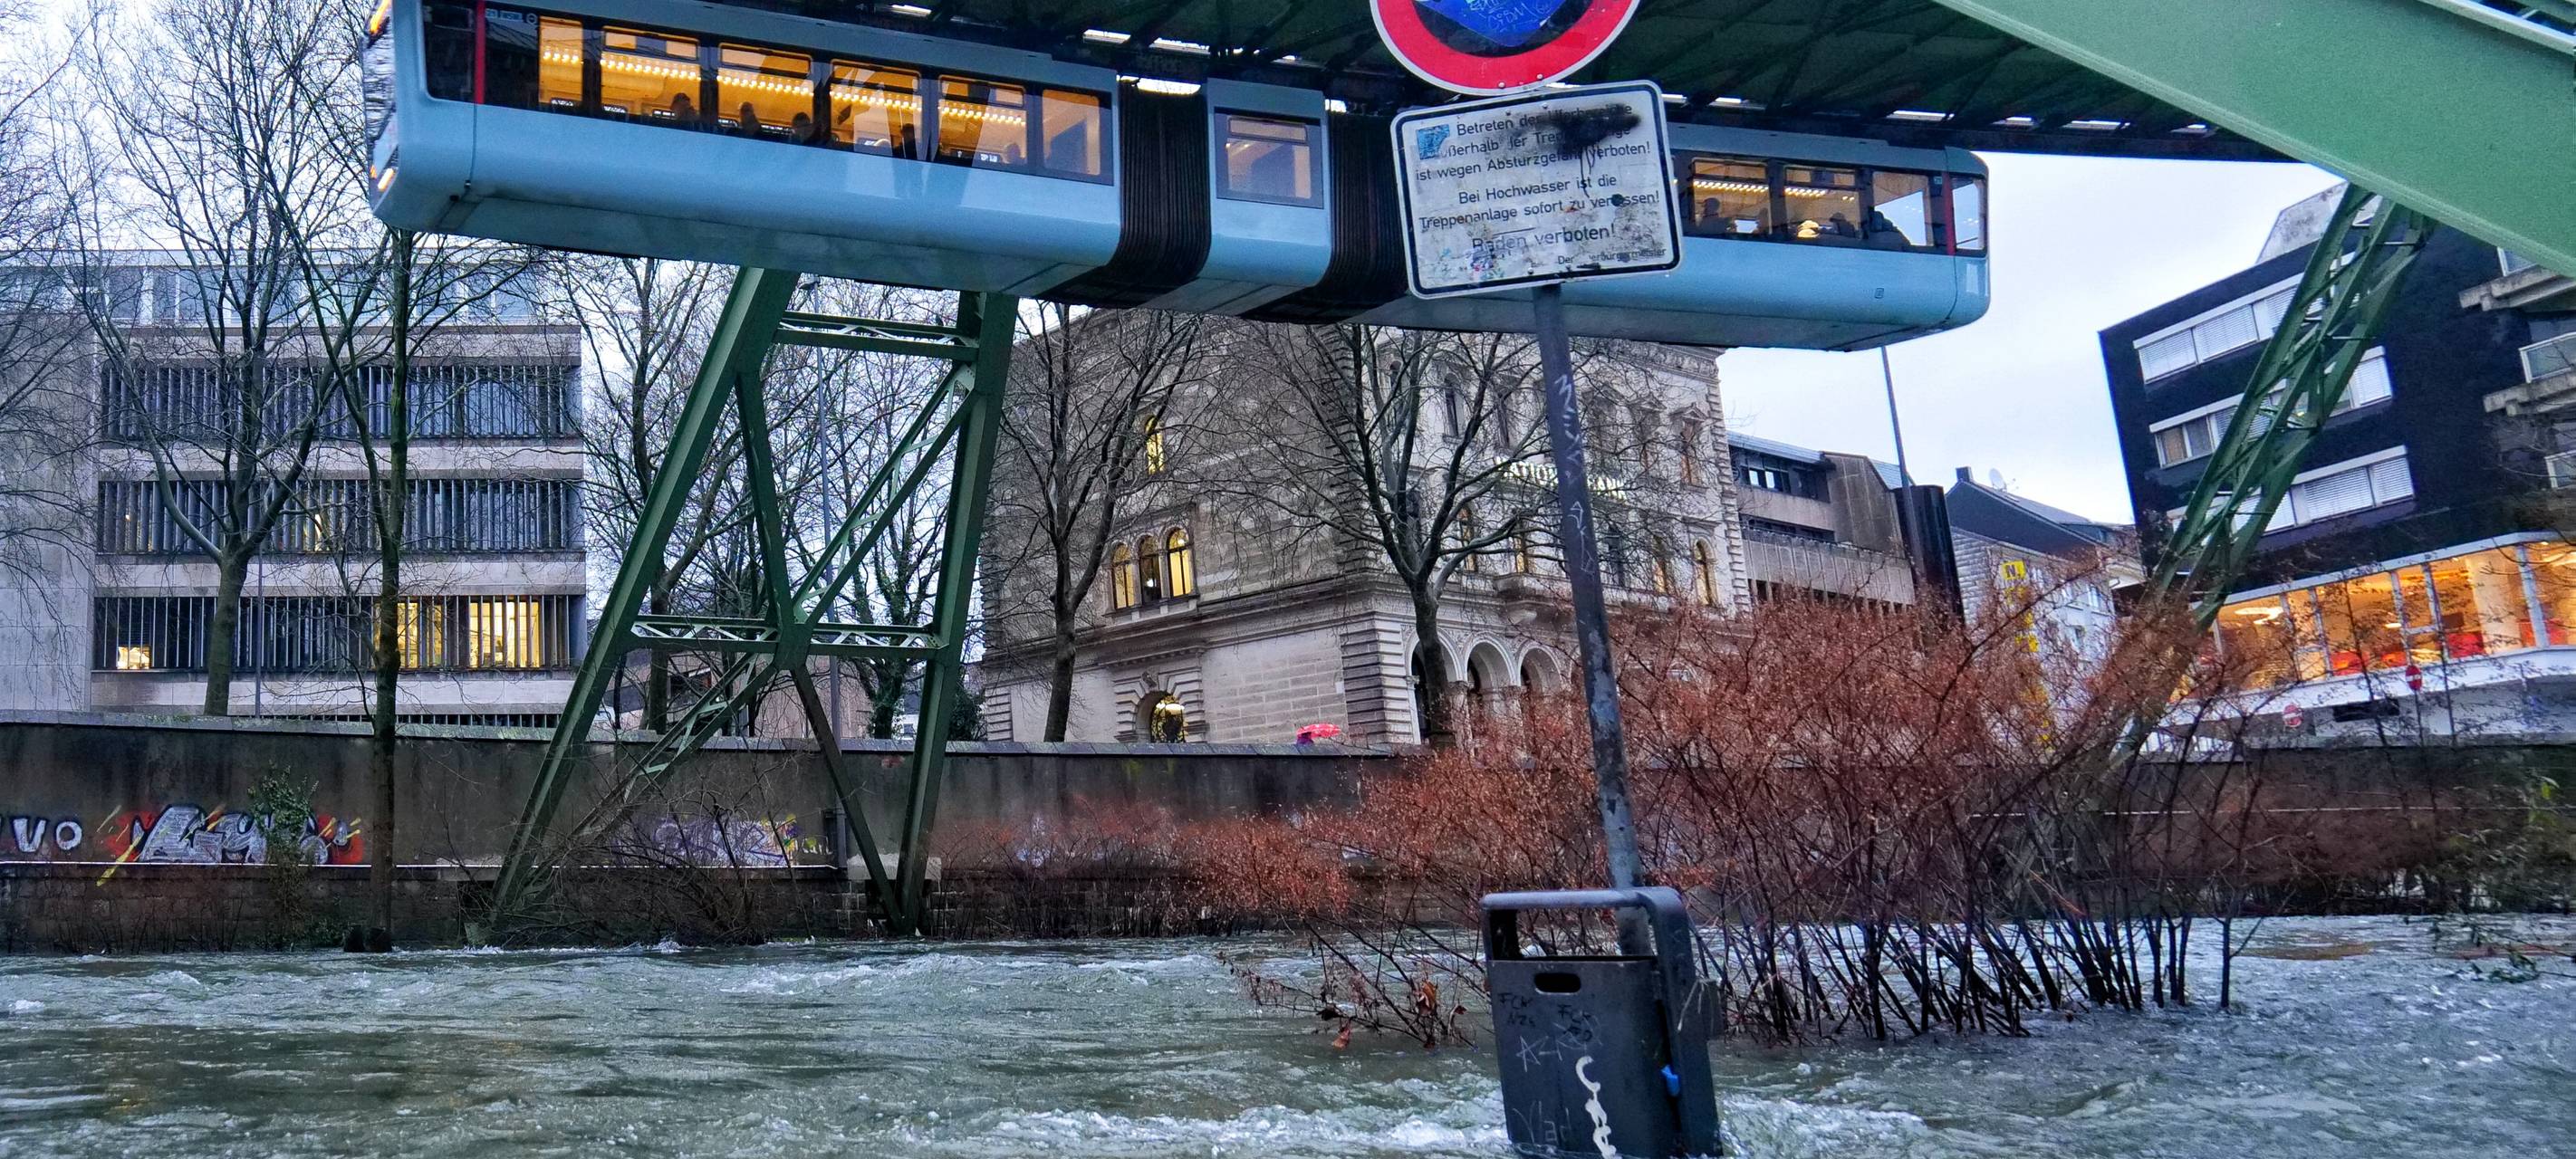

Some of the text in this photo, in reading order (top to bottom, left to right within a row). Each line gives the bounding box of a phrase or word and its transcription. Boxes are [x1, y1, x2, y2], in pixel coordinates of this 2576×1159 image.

[1457, 118, 1514, 136] Betreten
[1416, 169, 1432, 181] ist
[1437, 163, 1482, 179] wegen
[1588, 141, 1650, 158] verboten!
[1458, 175, 1617, 204] Bei Hochwasser ist die
[1419, 207, 1518, 230] Treppenanlage
[1523, 198, 1564, 216] sofort
[1569, 197, 1585, 211] zu
[1534, 223, 1616, 245] verboten!
[1557, 254, 1575, 265] Der
